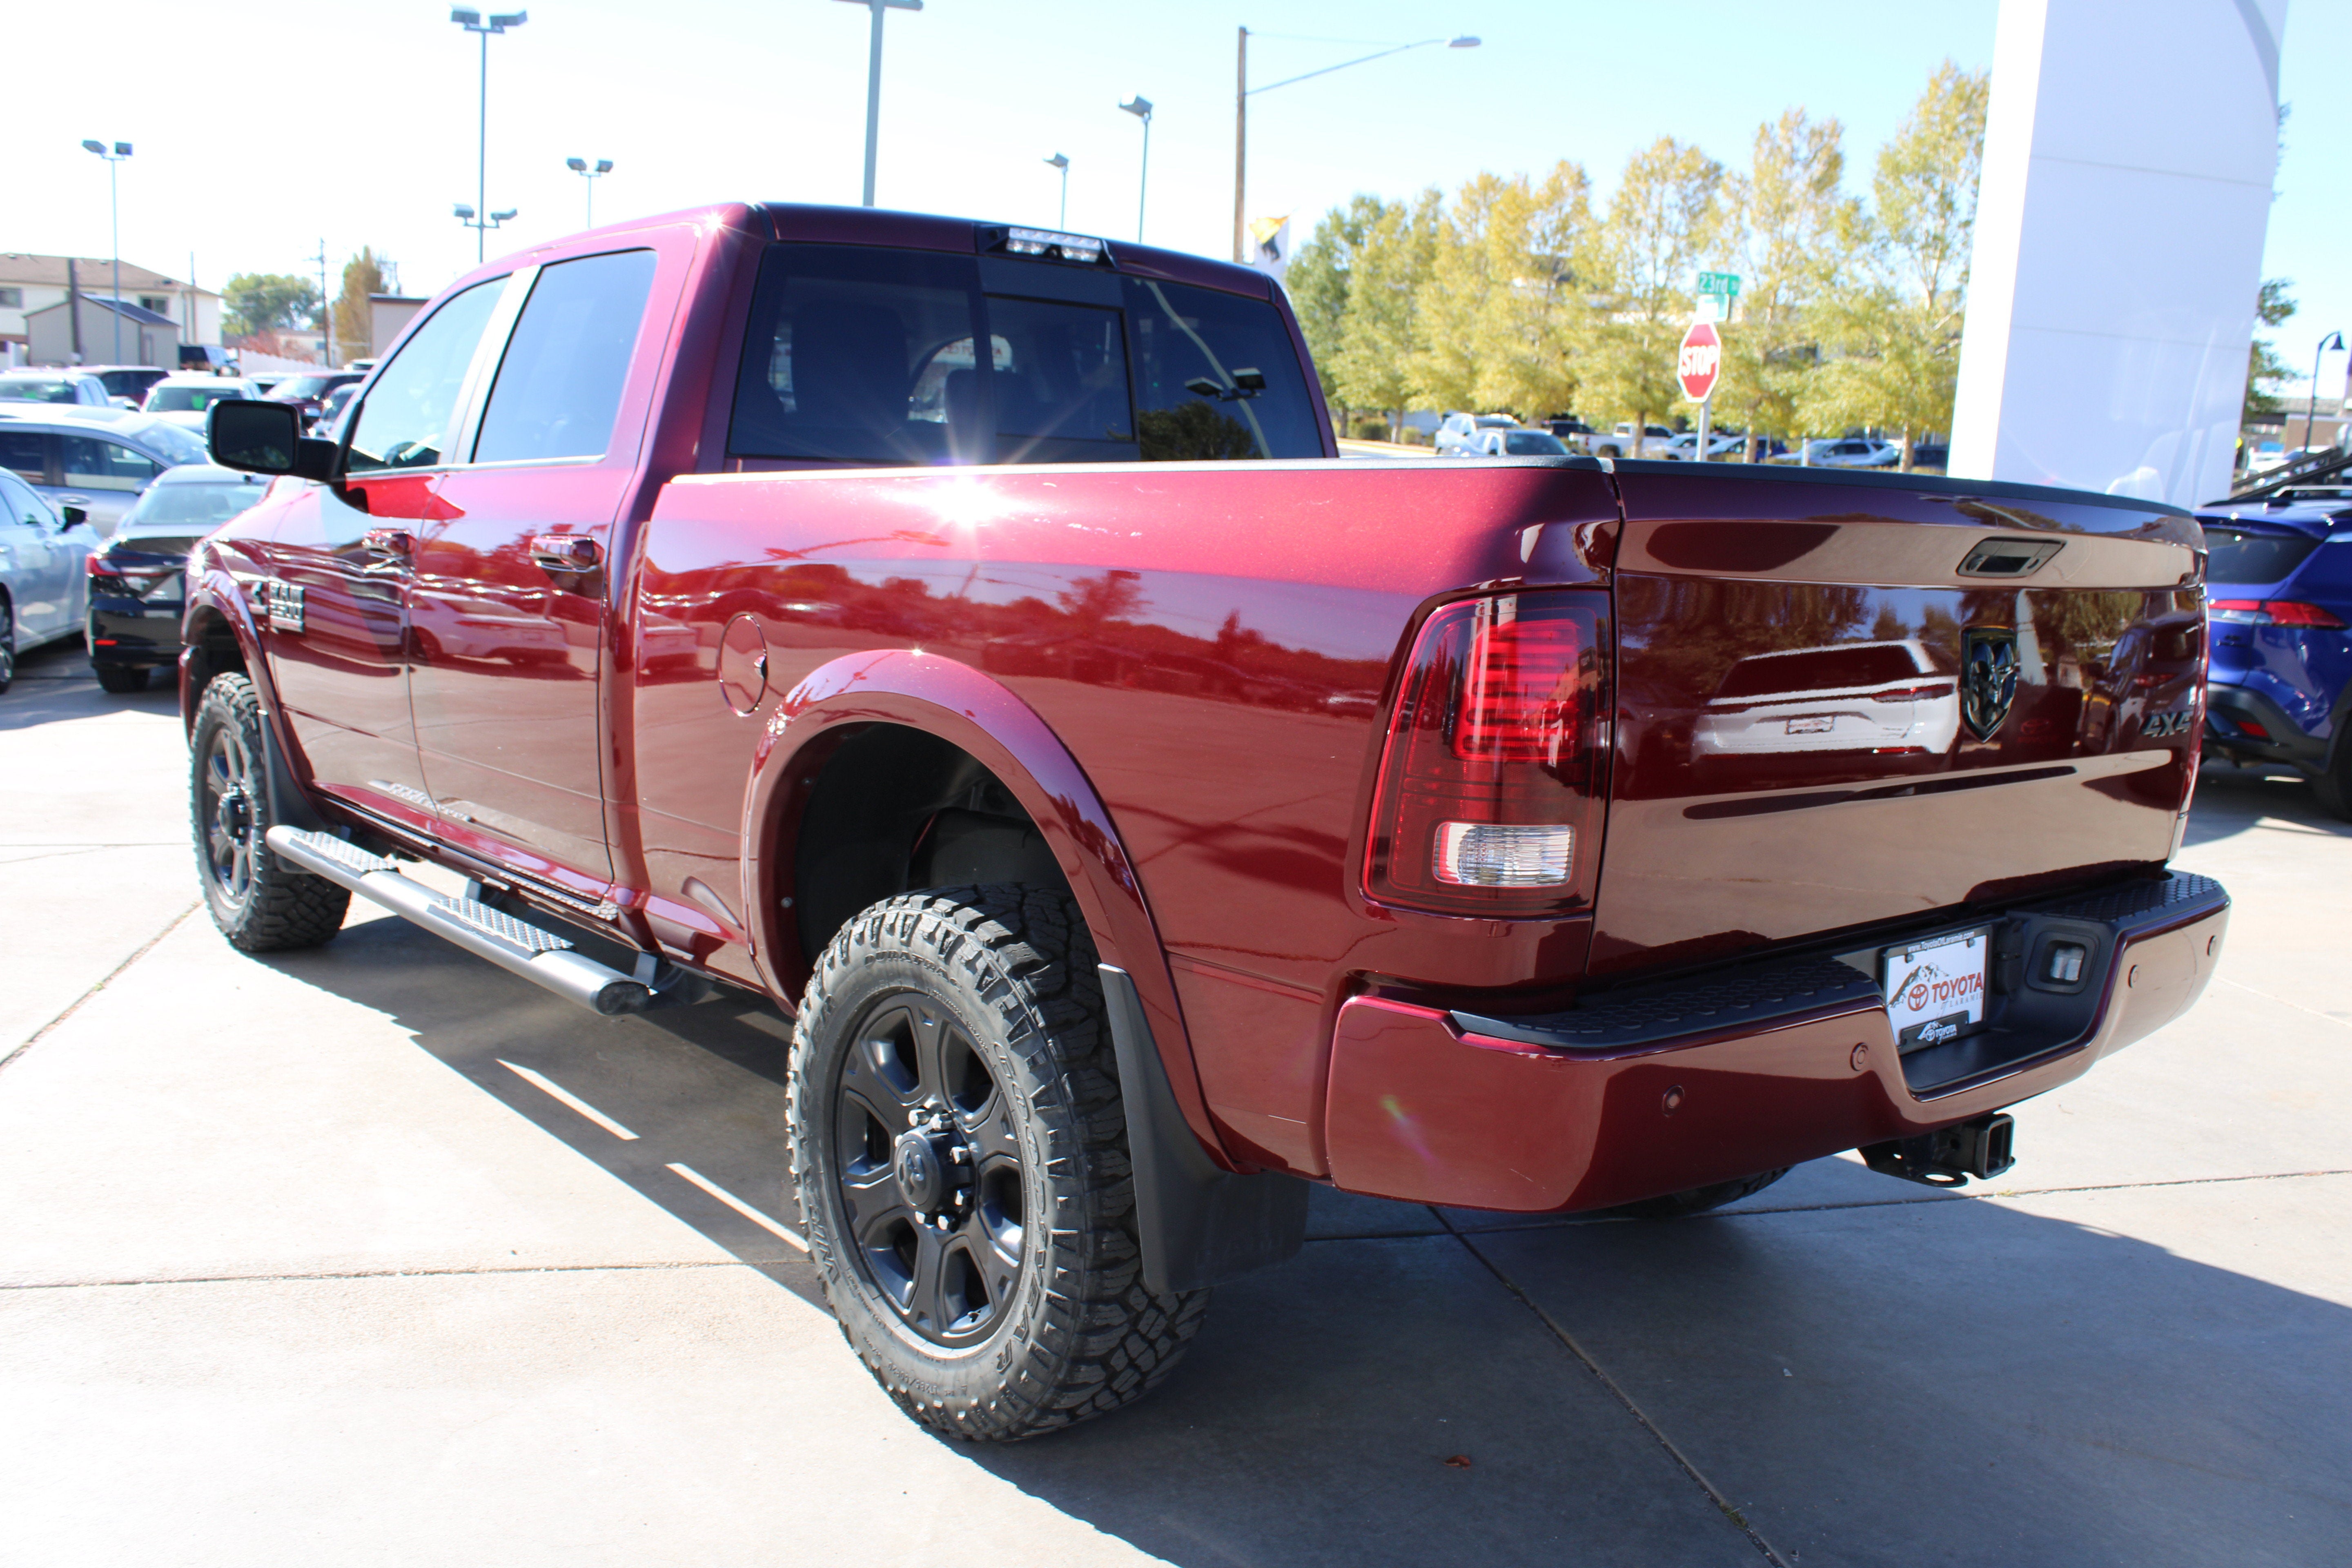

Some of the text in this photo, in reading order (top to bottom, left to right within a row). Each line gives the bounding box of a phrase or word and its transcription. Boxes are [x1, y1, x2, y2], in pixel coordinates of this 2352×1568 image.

[1699, 273, 1728, 293] 23rd
[1682, 345, 1717, 376] STOP
[865, 949, 963, 993] DURATRAC
[1932, 972, 1984, 1003] TOYOTA
[993, 1042, 1047, 1374] GOODYEAR
